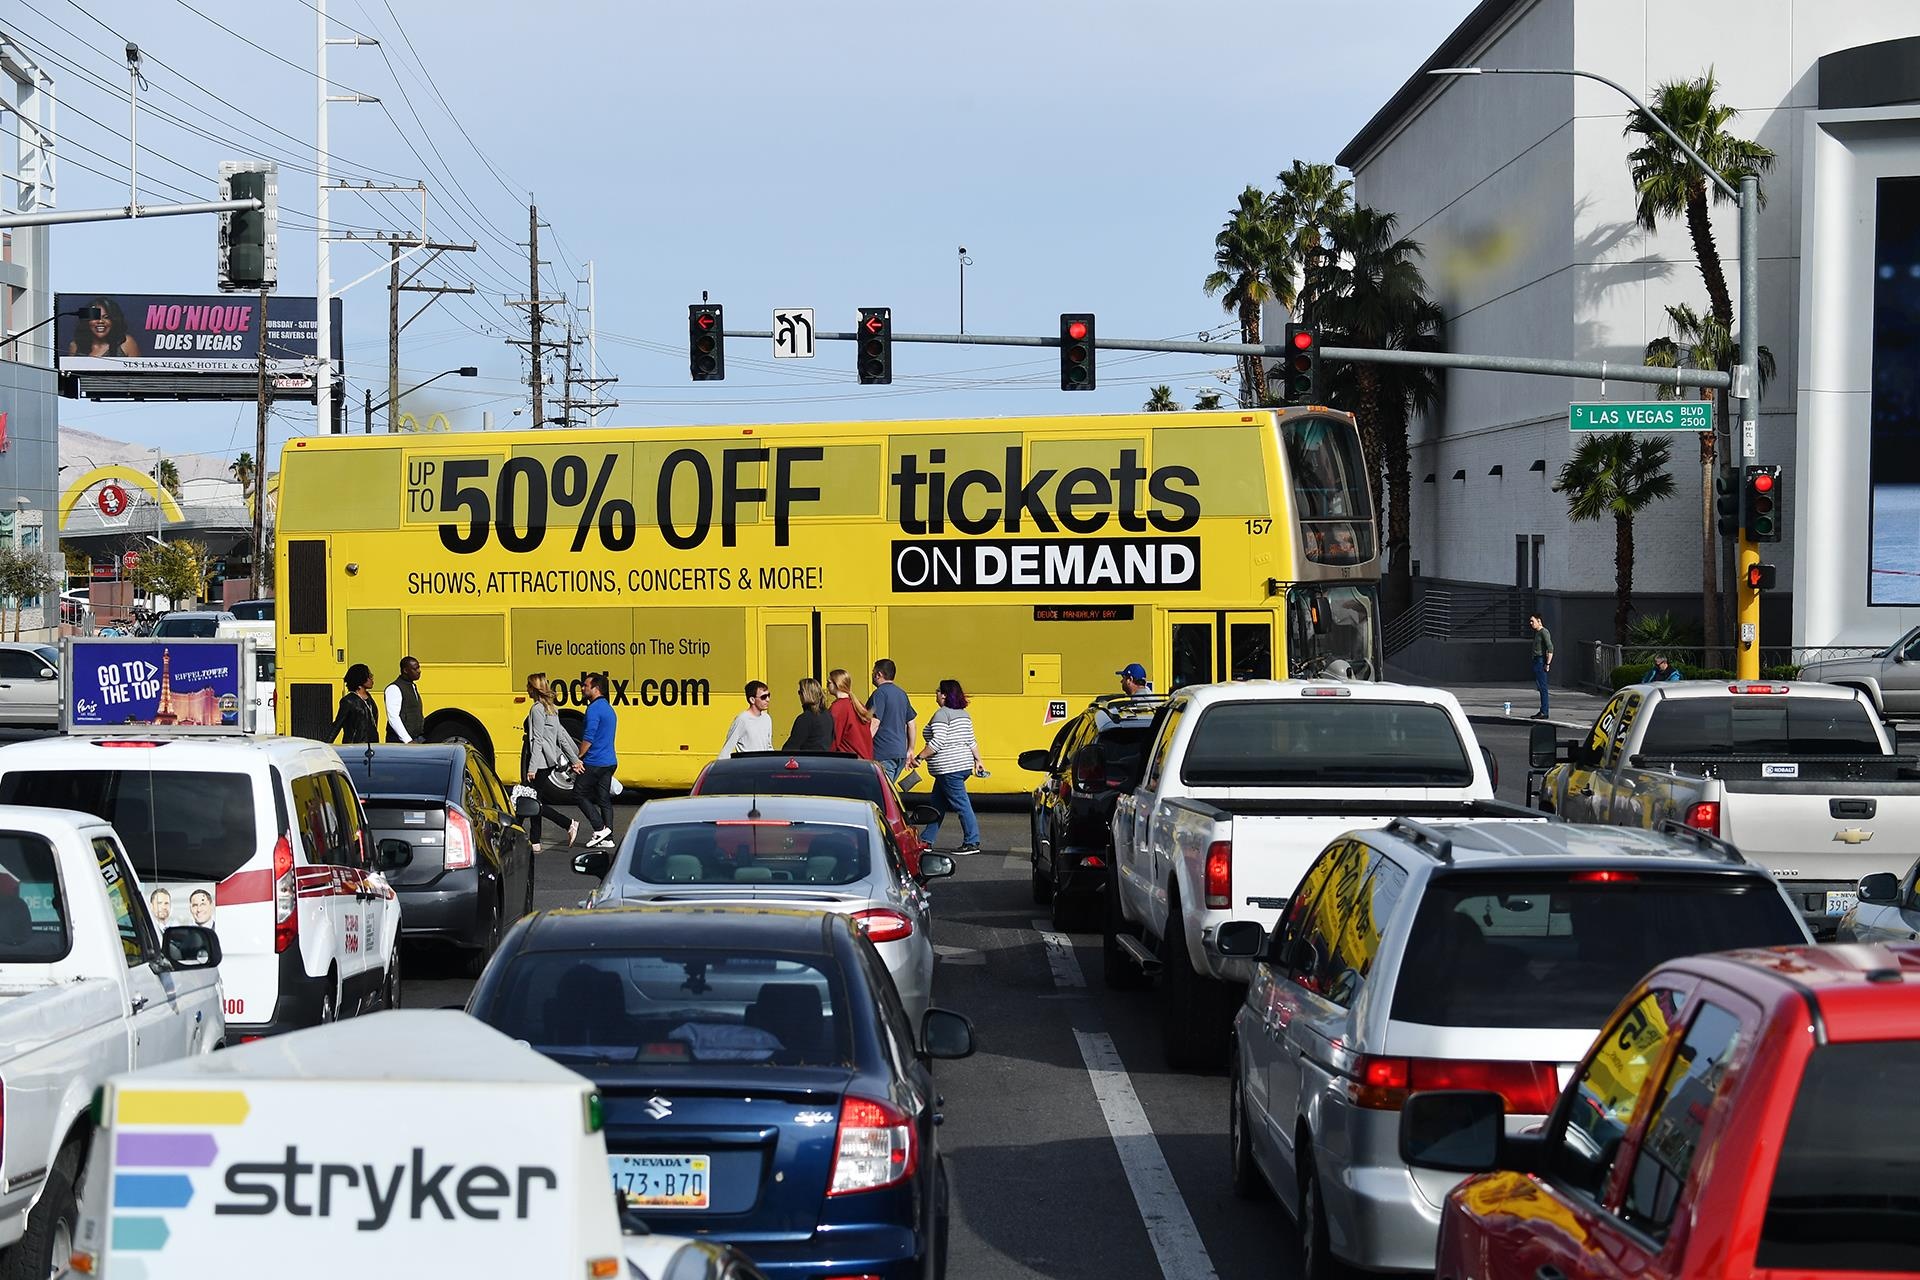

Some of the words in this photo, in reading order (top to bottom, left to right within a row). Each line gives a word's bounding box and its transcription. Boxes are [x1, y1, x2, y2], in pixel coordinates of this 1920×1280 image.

[145, 304, 252, 334] MO'NIQUE
[266, 320, 294, 329] URSDAY
[154, 334, 193, 350] DOES
[196, 334, 243, 351] VEGAS
[268, 331, 280, 339] THE
[280, 331, 305, 339] SAYERS
[142, 361, 159, 369] LAS
[1576, 408, 1583, 417] S
[1590, 411, 1619, 424] LAS
[1626, 410, 1674, 424] VEGAS
[1680, 407, 1704, 415] BLVD
[1680, 417, 1706, 426] 2500
[409, 462, 436, 486] UP
[408, 488, 434, 513] TO
[438, 454, 636, 554] 50%
[656, 447, 824, 550] OFF
[891, 446, 1200, 535] tickets
[1245, 519, 1273, 535] 157
[896, 545, 962, 586] ON
[975, 544, 1196, 586] DEMAND
[408, 571, 482, 598] SHOWS,
[486, 569, 622, 596] ATTRACTIONS,
[628, 568, 731, 592] CONCERTS
[738, 568, 752, 589] &
[759, 567, 824, 590] MORE!
[1037, 610, 1058, 619] DEUCE
[536, 640, 562, 656] Five
[566, 639, 626, 656] locations
[630, 643, 646, 656] on
[650, 638, 675, 655] The
[678, 637, 711, 658] Strip
[98, 664, 120, 687] GO
[122, 660, 145, 683] TO
[100, 683, 130, 705] THE
[131, 679, 160, 701] TOP
[77, 698, 98, 714] Paris
[632, 1158, 682, 1167] NEVADA
[213, 1145, 558, 1231] stryker
[612, 1172, 648, 1196] 173
